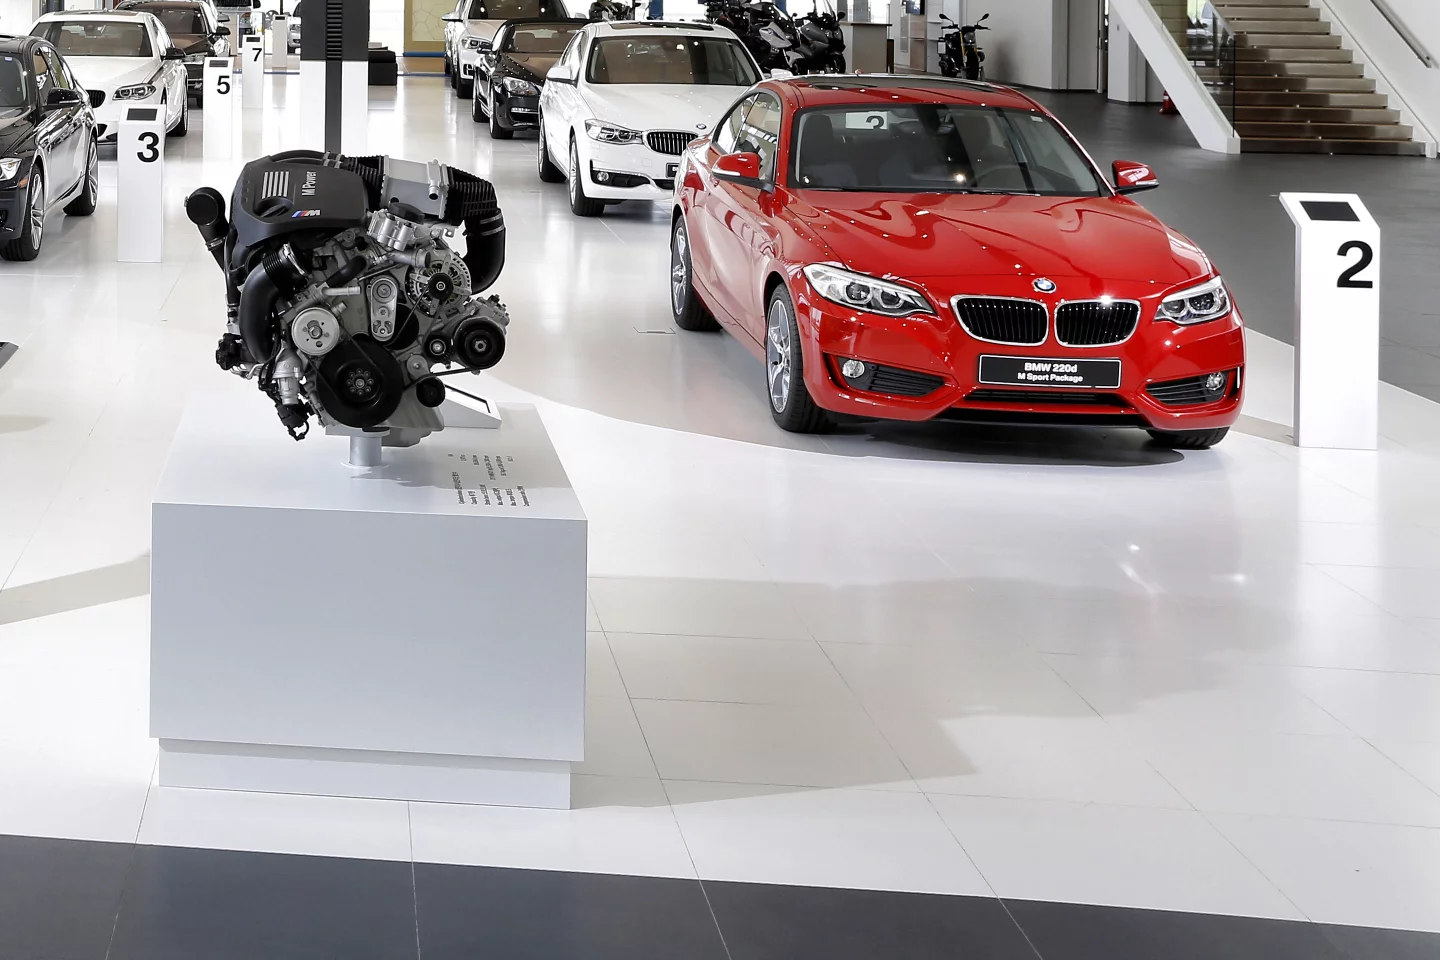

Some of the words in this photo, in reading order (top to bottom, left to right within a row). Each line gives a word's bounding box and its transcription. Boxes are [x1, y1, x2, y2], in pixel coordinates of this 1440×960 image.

[251, 48, 262, 62] 7
[216, 75, 231, 95] 5
[137, 131, 160, 162] 3
[1336, 240, 1373, 289] 2
[1024, 362, 1052, 372] BMW
[1052, 363, 1078, 373] 220d
[1017, 372, 1026, 380] M
[1026, 373, 1050, 382] Sport
[1050, 373, 1084, 383] Package
